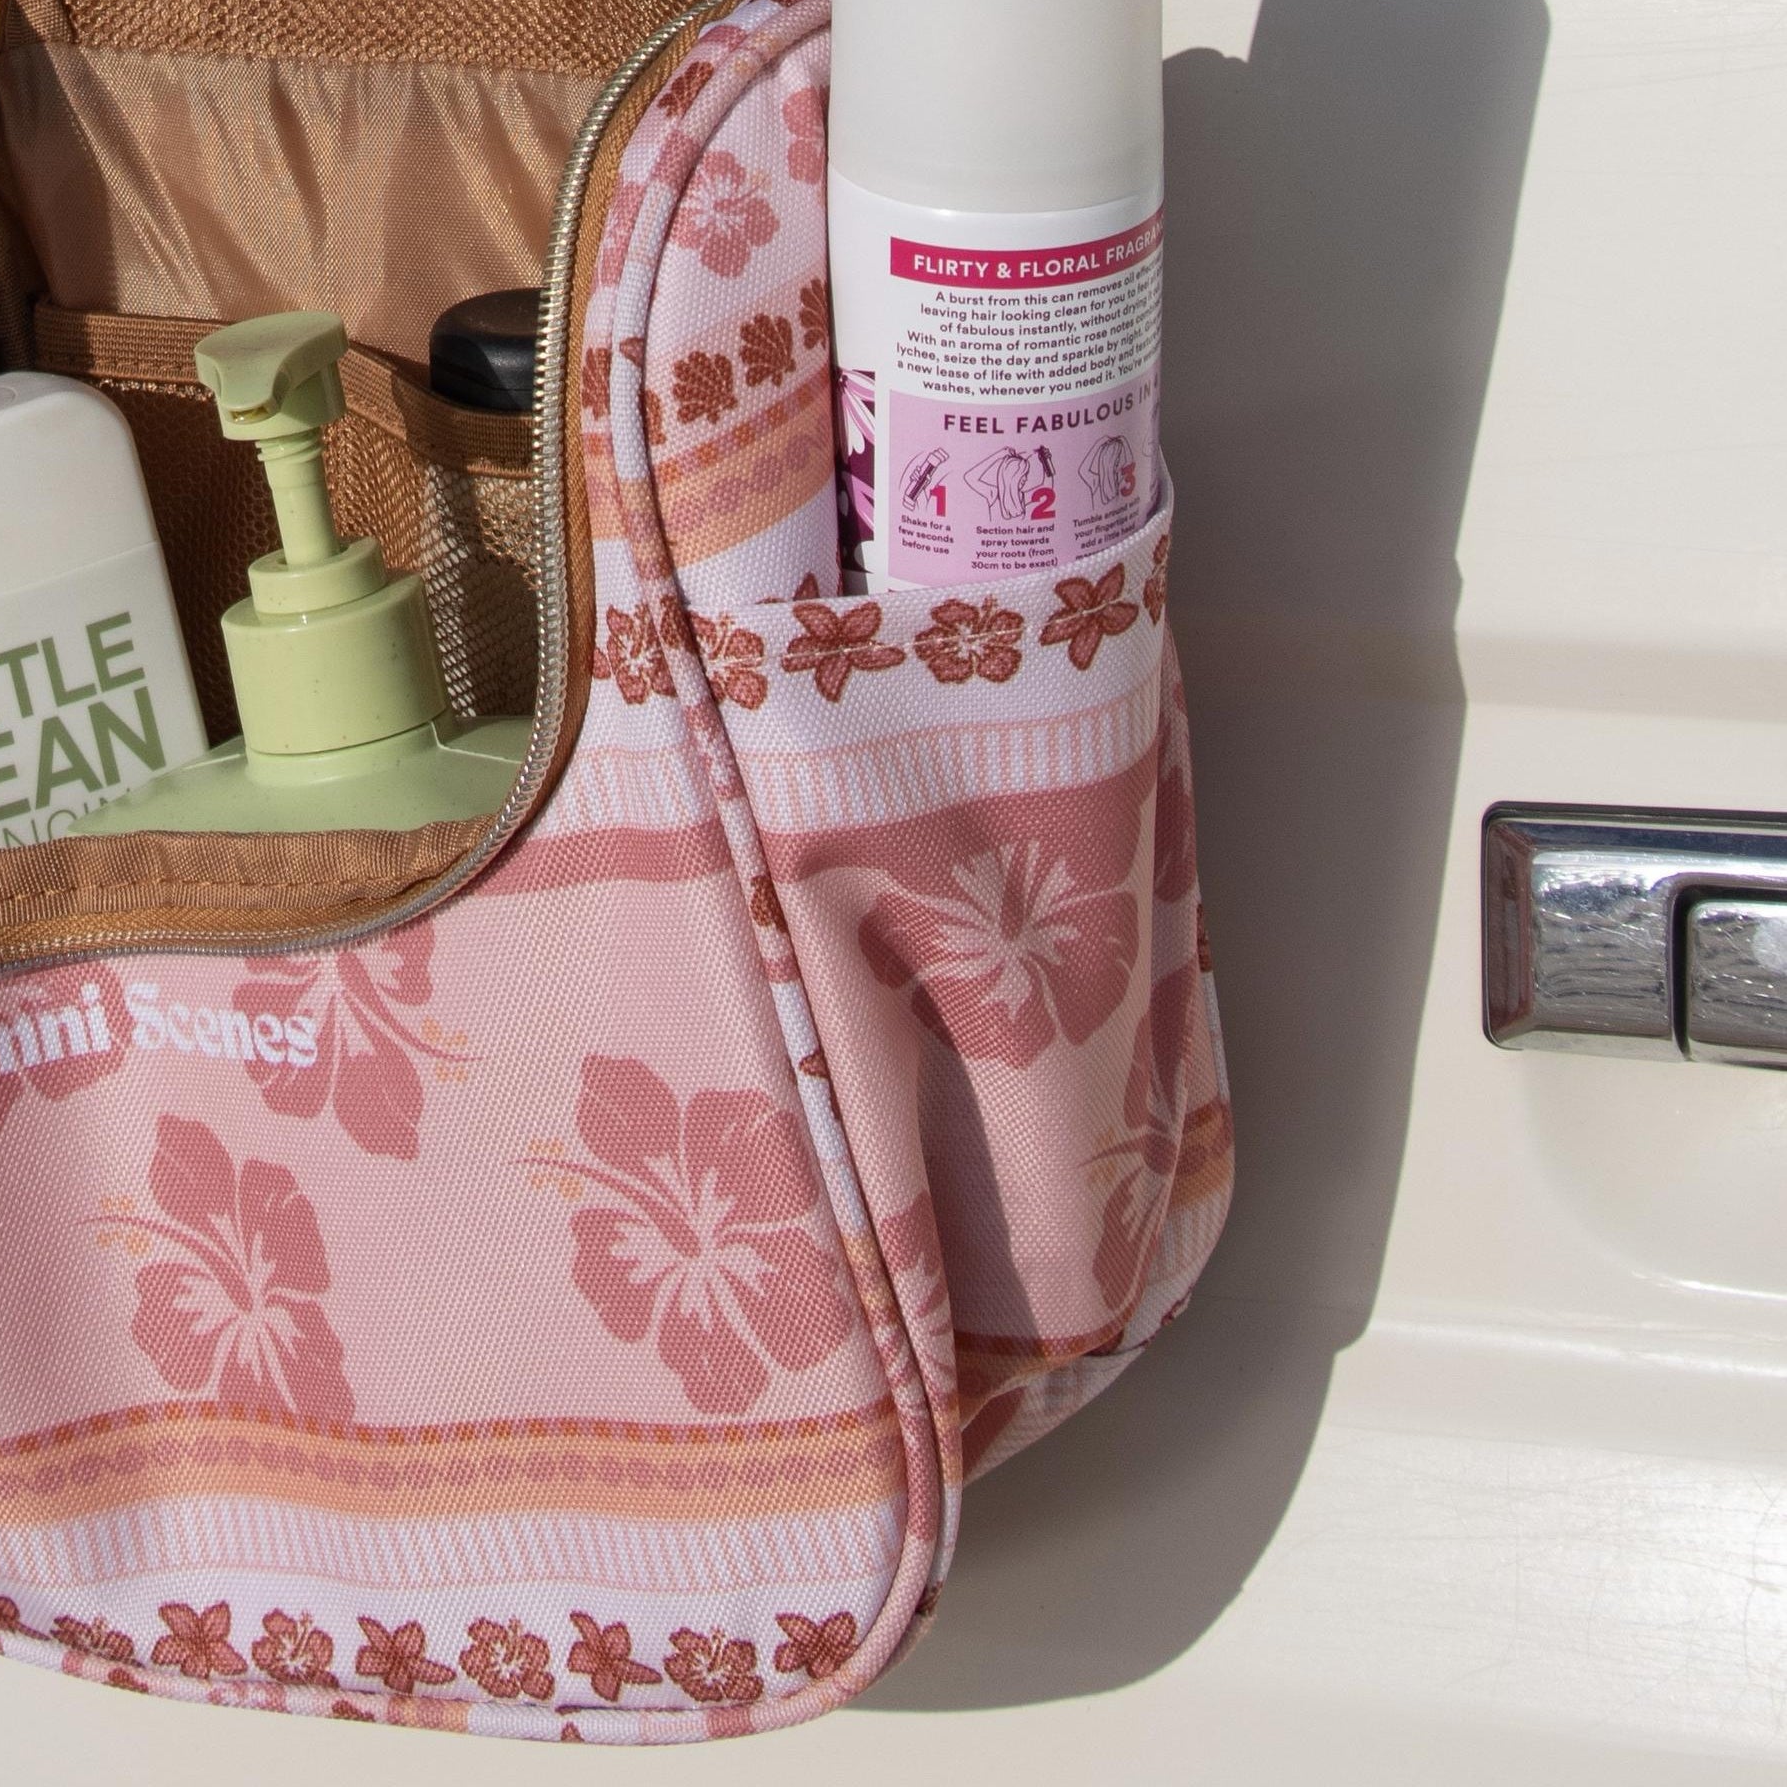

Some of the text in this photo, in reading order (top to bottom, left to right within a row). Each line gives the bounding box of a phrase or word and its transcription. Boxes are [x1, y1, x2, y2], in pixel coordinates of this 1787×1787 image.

[914, 254, 989, 278] FLIRTY
[997, 262, 1011, 279] &
[1020, 253, 1100, 278] FLORAL
[935, 291, 945, 302] A
[949, 293, 984, 306] burst
[988, 295, 1020, 306] from
[1024, 294, 1048, 306] this
[1052, 292, 1074, 304] can
[1077, 279, 1122, 300] removes
[921, 303, 967, 322] leaving
[972, 309, 996, 321] hair
[1001, 310, 1050, 322] looking
[1055, 305, 1087, 318] clean
[1091, 300, 1105, 312] for
[1108, 294, 1126, 308] you
[907, 330, 936, 346] With
[940, 339, 956, 349] an
[960, 340, 1002, 351] aroma
[1006, 340, 1020, 351] of
[1024, 335, 1081, 351] romantic
[1084, 329, 1107, 343] rose
[1110, 319, 1134, 336] notes
[940, 322, 953, 333] of
[957, 322, 1015, 336] fabulous
[1019, 321, 1076, 336] instantly,
[1081, 309, 1121, 329] without
[896, 342, 940, 363] lychee,
[944, 353, 977, 365] seize
[981, 355, 1003, 366] the
[1006, 355, 1030, 368] day
[1035, 352, 1058, 364] and
[1062, 344, 1104, 363] sparkle
[1107, 340, 1119, 352] by
[897, 360, 904, 369] a
[907, 363, 932, 375] new
[936, 365, 970, 379] lease
[974, 369, 988, 380] of
[991, 369, 1012, 381] life
[1016, 368, 1044, 381] with
[1049, 362, 1087, 378] added
[1090, 355, 1116, 371] body
[1119, 346, 1134, 361] and
[923, 381, 975, 396] washes,
[979, 385, 1045, 396] whenever
[1049, 382, 1072, 395] you
[1075, 374, 1103, 389] need
[1106, 371, 1115, 381] it.
[944, 414, 1004, 434] FEEL
[1016, 393, 1133, 433] FABULOUS
[1120, 462, 1136, 497] 3
[930, 485, 946, 517] 1
[1031, 487, 1056, 520] 2
[898, 525, 954, 544] few seconds
[901, 515, 927, 528] Shake
[930, 521, 943, 531] for
[976, 524, 1055, 535] Section hair and
[902, 539, 949, 555] before use
[976, 547, 1054, 559] your roots (from
[981, 536, 1049, 548] spray towards
[971, 557, 1058, 570] 30cm to be exact)
[124, 982, 318, 1068] Scenes
